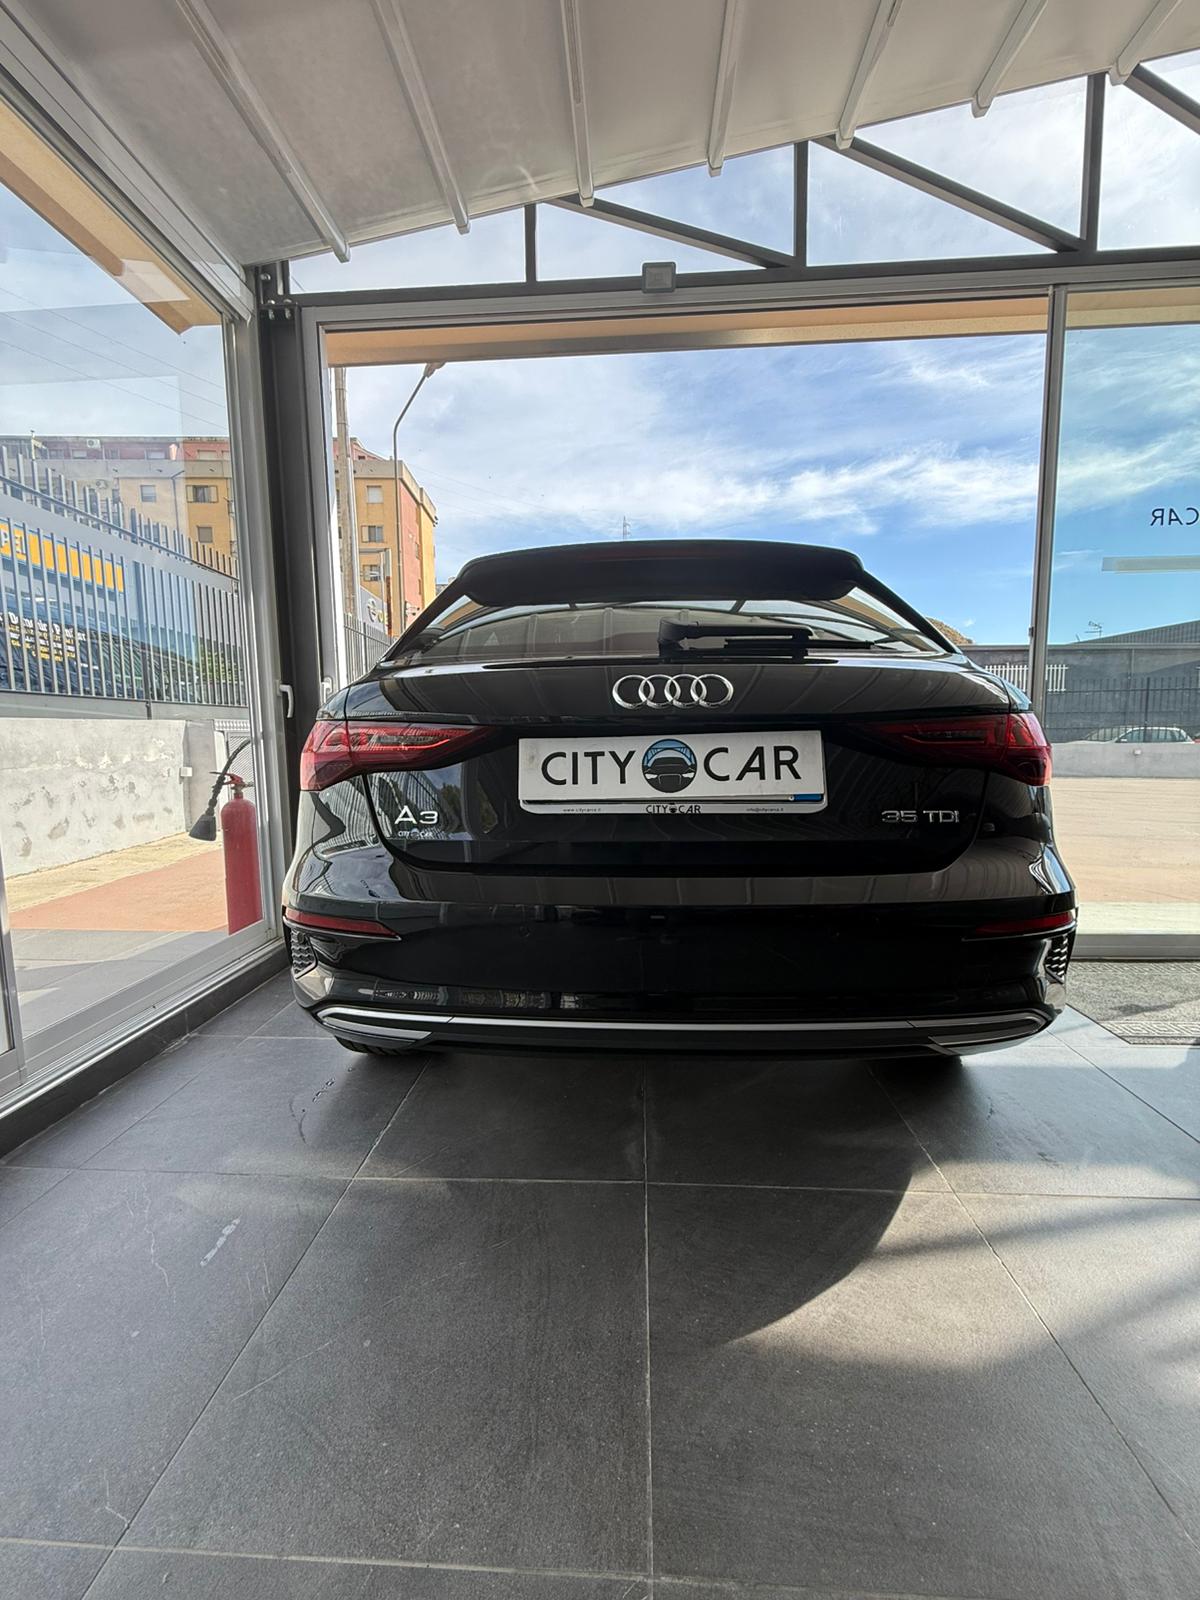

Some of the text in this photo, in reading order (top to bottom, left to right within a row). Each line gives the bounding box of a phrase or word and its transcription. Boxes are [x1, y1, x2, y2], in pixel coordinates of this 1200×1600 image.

[541, 744, 802, 786] CITY CAR
[394, 805, 438, 825] A3
[645, 804, 702, 814] CITY CAR
[881, 810, 960, 823] 35 TDI
